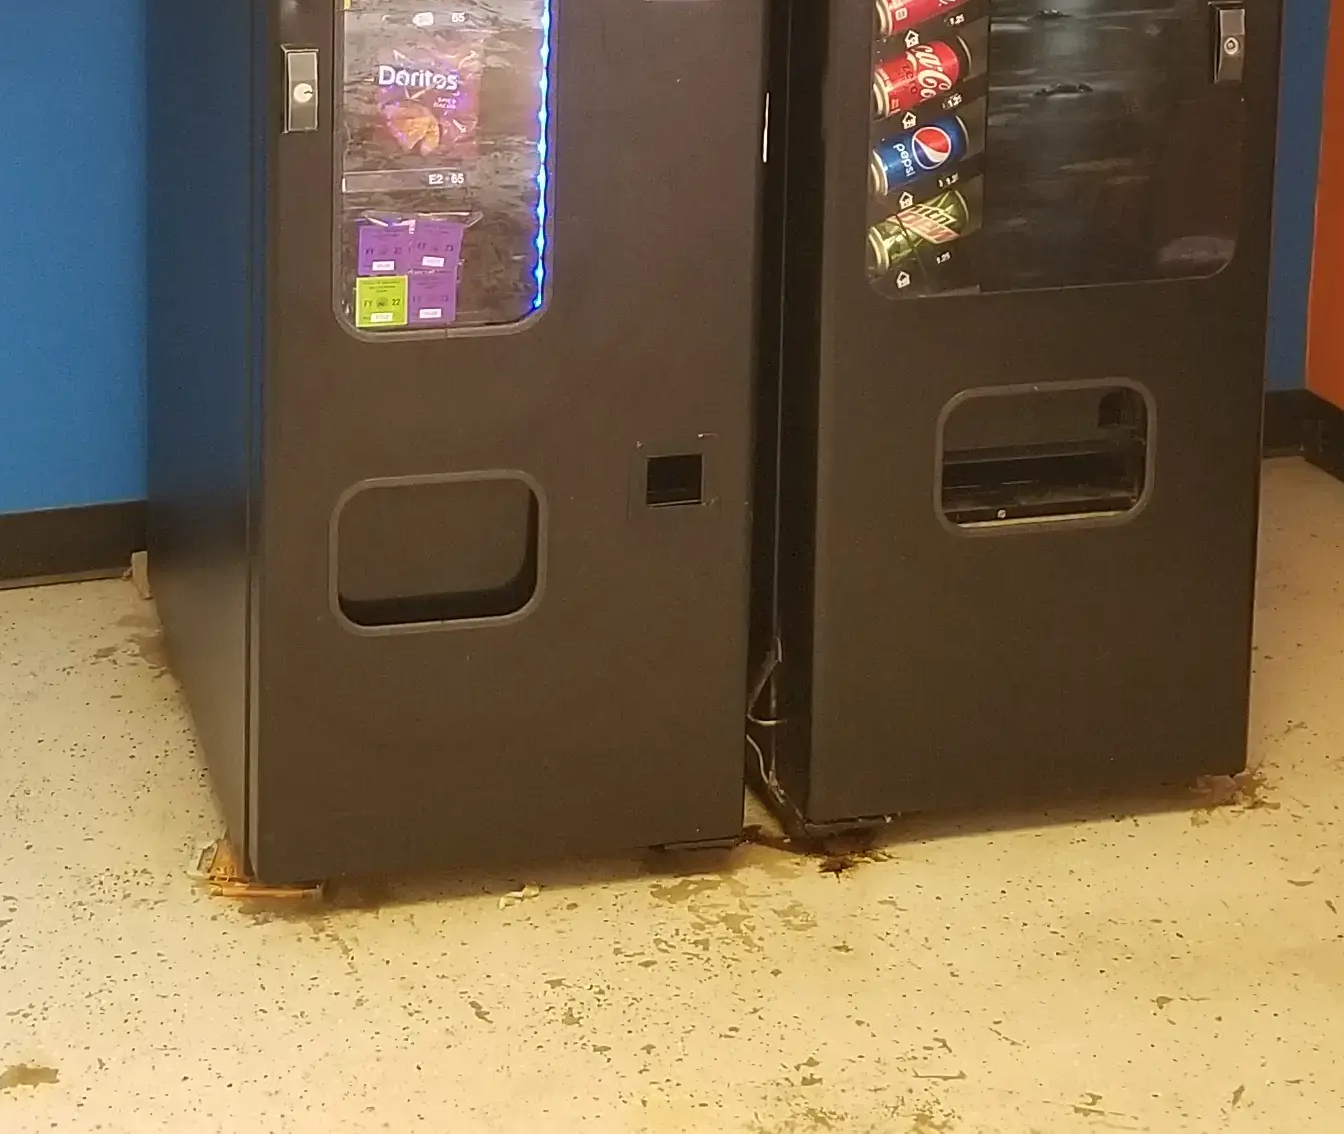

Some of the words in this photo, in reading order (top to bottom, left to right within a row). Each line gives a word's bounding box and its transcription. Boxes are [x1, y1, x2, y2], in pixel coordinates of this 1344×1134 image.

[451, 13, 466, 23] 65
[949, 13, 965, 25] 1.25
[378, 65, 460, 90] Doritos
[892, 142, 916, 177] pepsi
[428, 173, 444, 184] E2
[451, 173, 465, 184] 65
[936, 251, 951, 264] 1.25
[391, 298, 401, 306] 22
